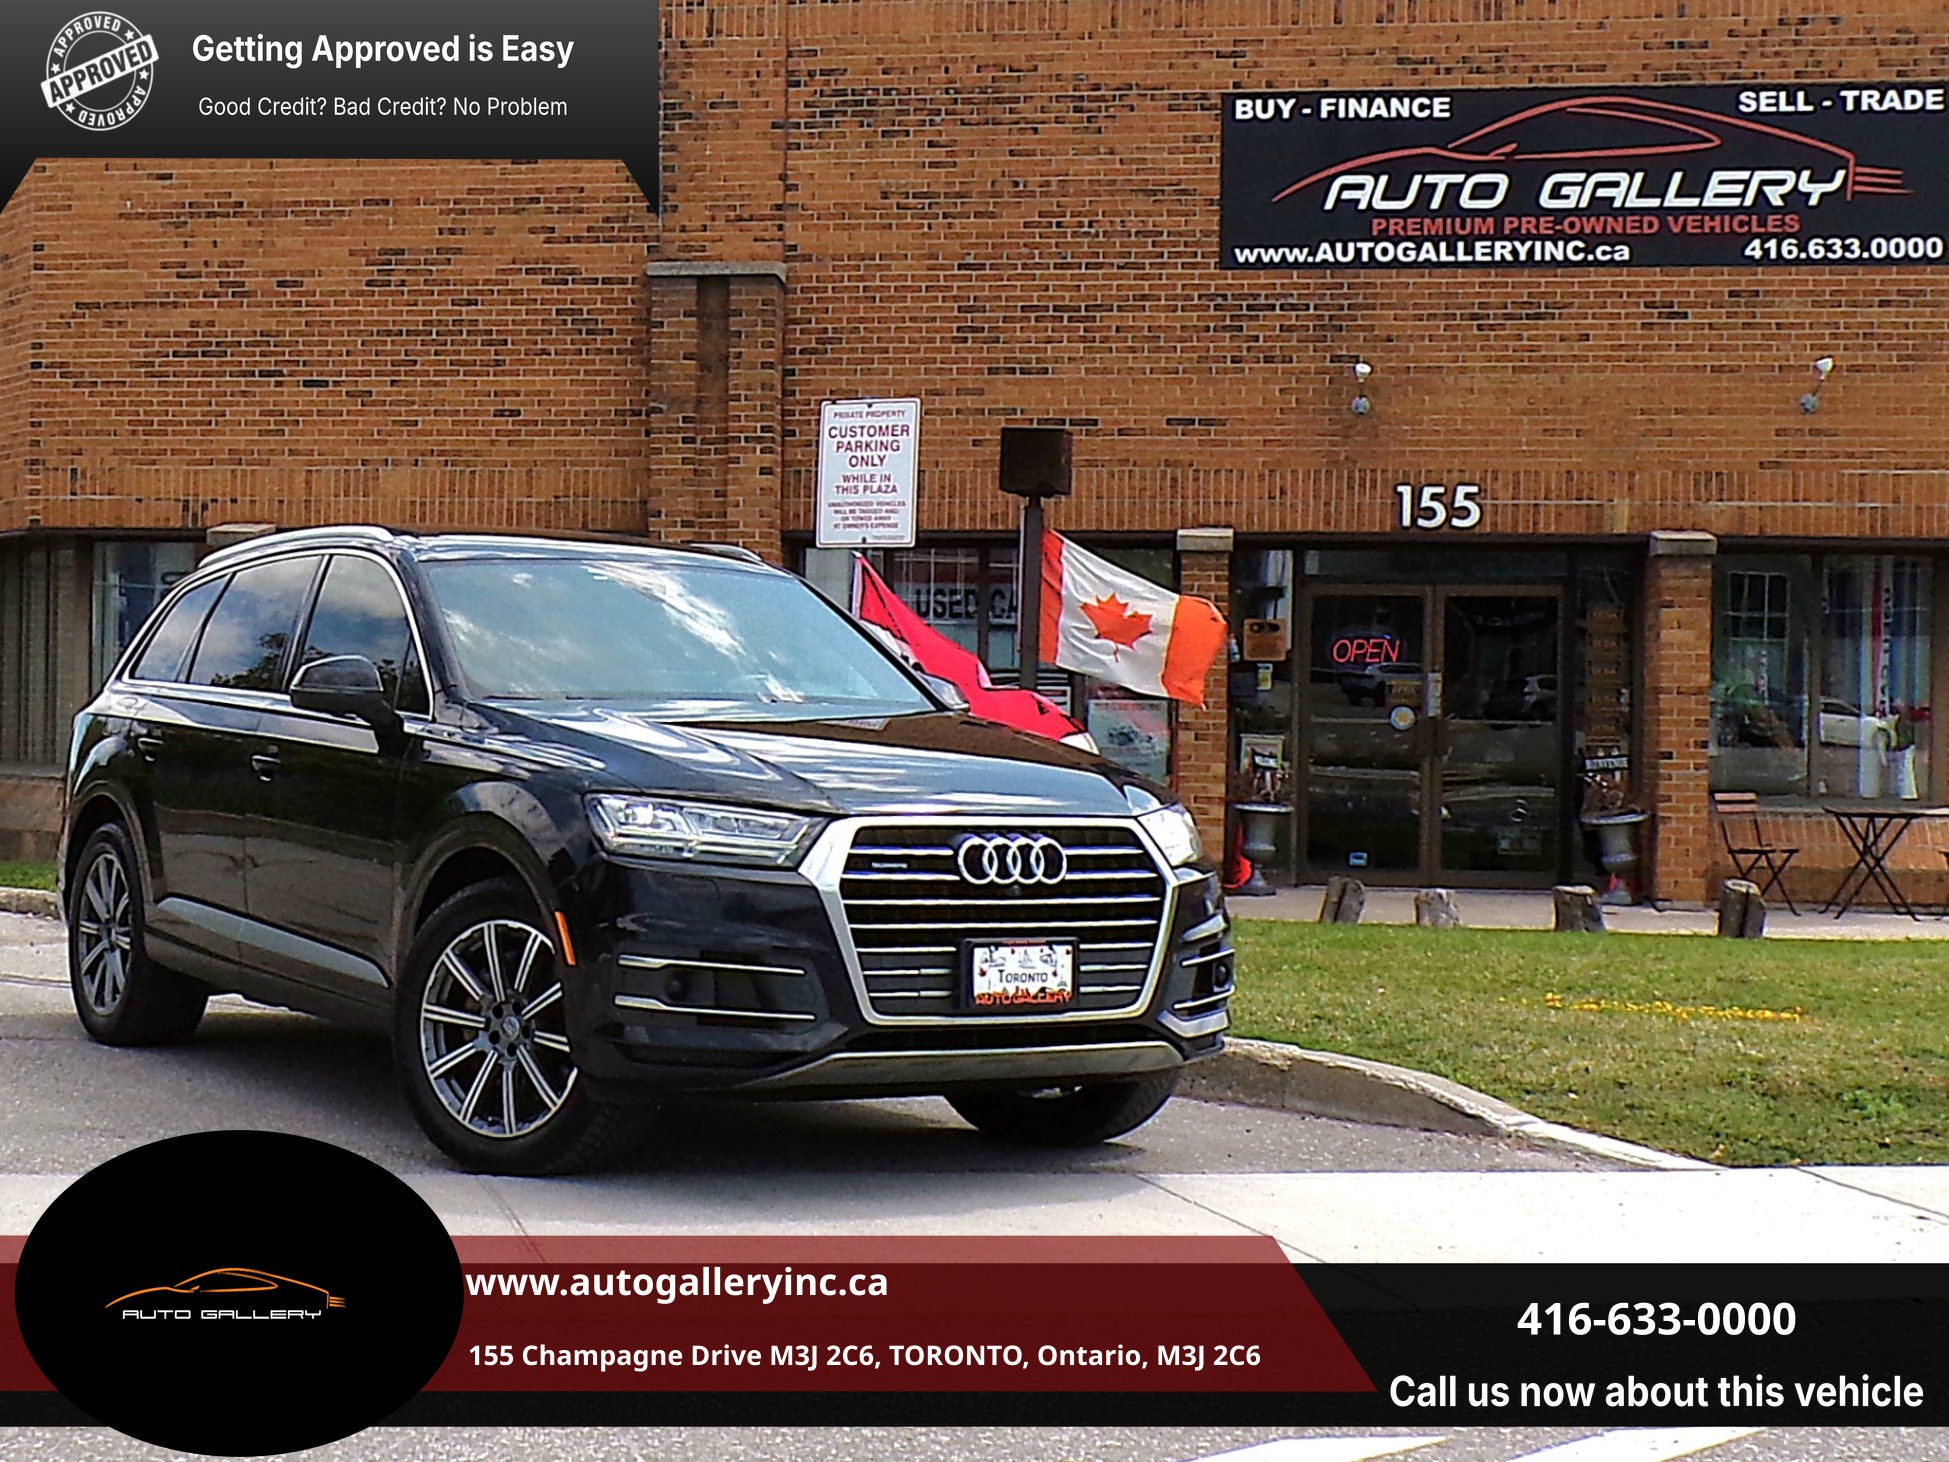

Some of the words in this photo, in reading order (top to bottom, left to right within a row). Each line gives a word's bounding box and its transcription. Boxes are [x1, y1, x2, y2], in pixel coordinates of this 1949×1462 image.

[1234, 98, 1296, 120] BUY
[1320, 97, 1451, 119] FINANCE
[1738, 90, 1814, 113] SELL
[1839, 88, 1945, 111] TRADE
[1322, 173, 1510, 210] AUTO
[1538, 169, 1848, 209] GALLERY
[1371, 217, 1495, 236] PREMIUM
[1503, 215, 1660, 235] PRE-OWNED
[1667, 214, 1802, 234] VEHICLES
[1233, 239, 1631, 264] www.AUTOGALLERYINC.ca
[1743, 237, 1944, 260] 416.633.0000
[865, 410, 906, 418] PROPERTY
[828, 424, 910, 438] CUSTOMER
[836, 440, 901, 453] PARKING
[848, 455, 887, 468] ONLY
[835, 485, 859, 495] THIS
[862, 484, 898, 494] PLAZA
[842, 474, 877, 483] WHILE
[880, 473, 891, 483] IN
[1397, 485, 1481, 528] 155
[915, 589, 979, 618] USED
[1332, 638, 1401, 663] OPEN
